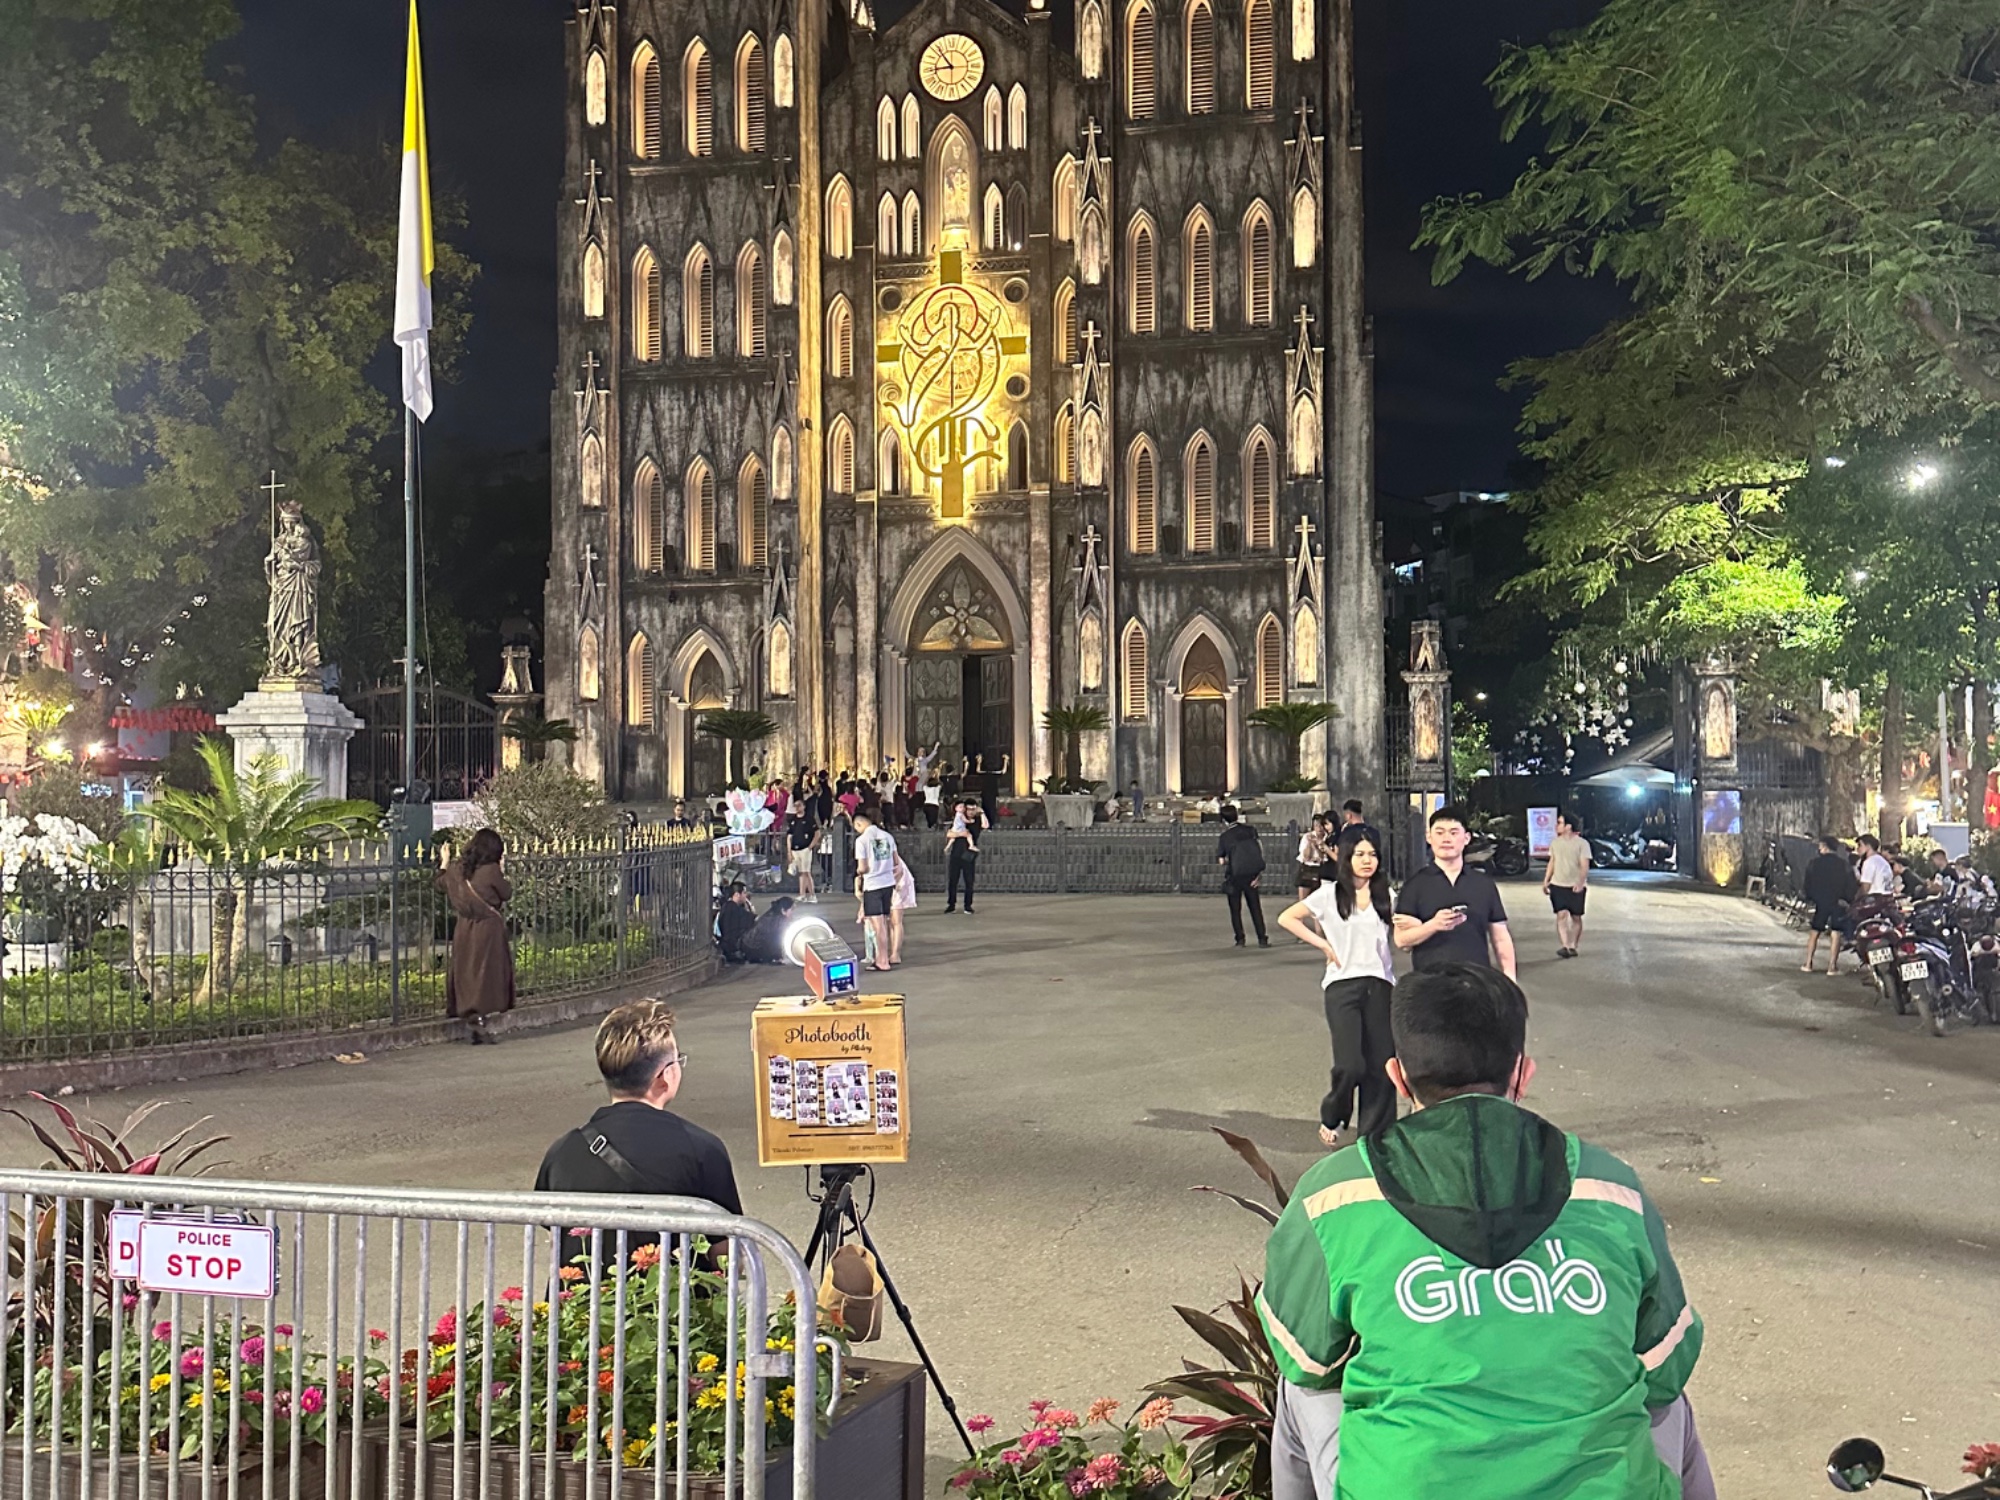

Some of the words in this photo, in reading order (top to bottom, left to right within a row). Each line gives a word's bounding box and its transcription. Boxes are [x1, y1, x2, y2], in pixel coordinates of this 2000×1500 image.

[785, 1020, 871, 1043] Photobooth
[120, 1241, 139, 1260] D
[178, 1231, 231, 1247] POLICE
[167, 1254, 242, 1280] STOP
[1395, 1239, 1607, 1323] Grab
